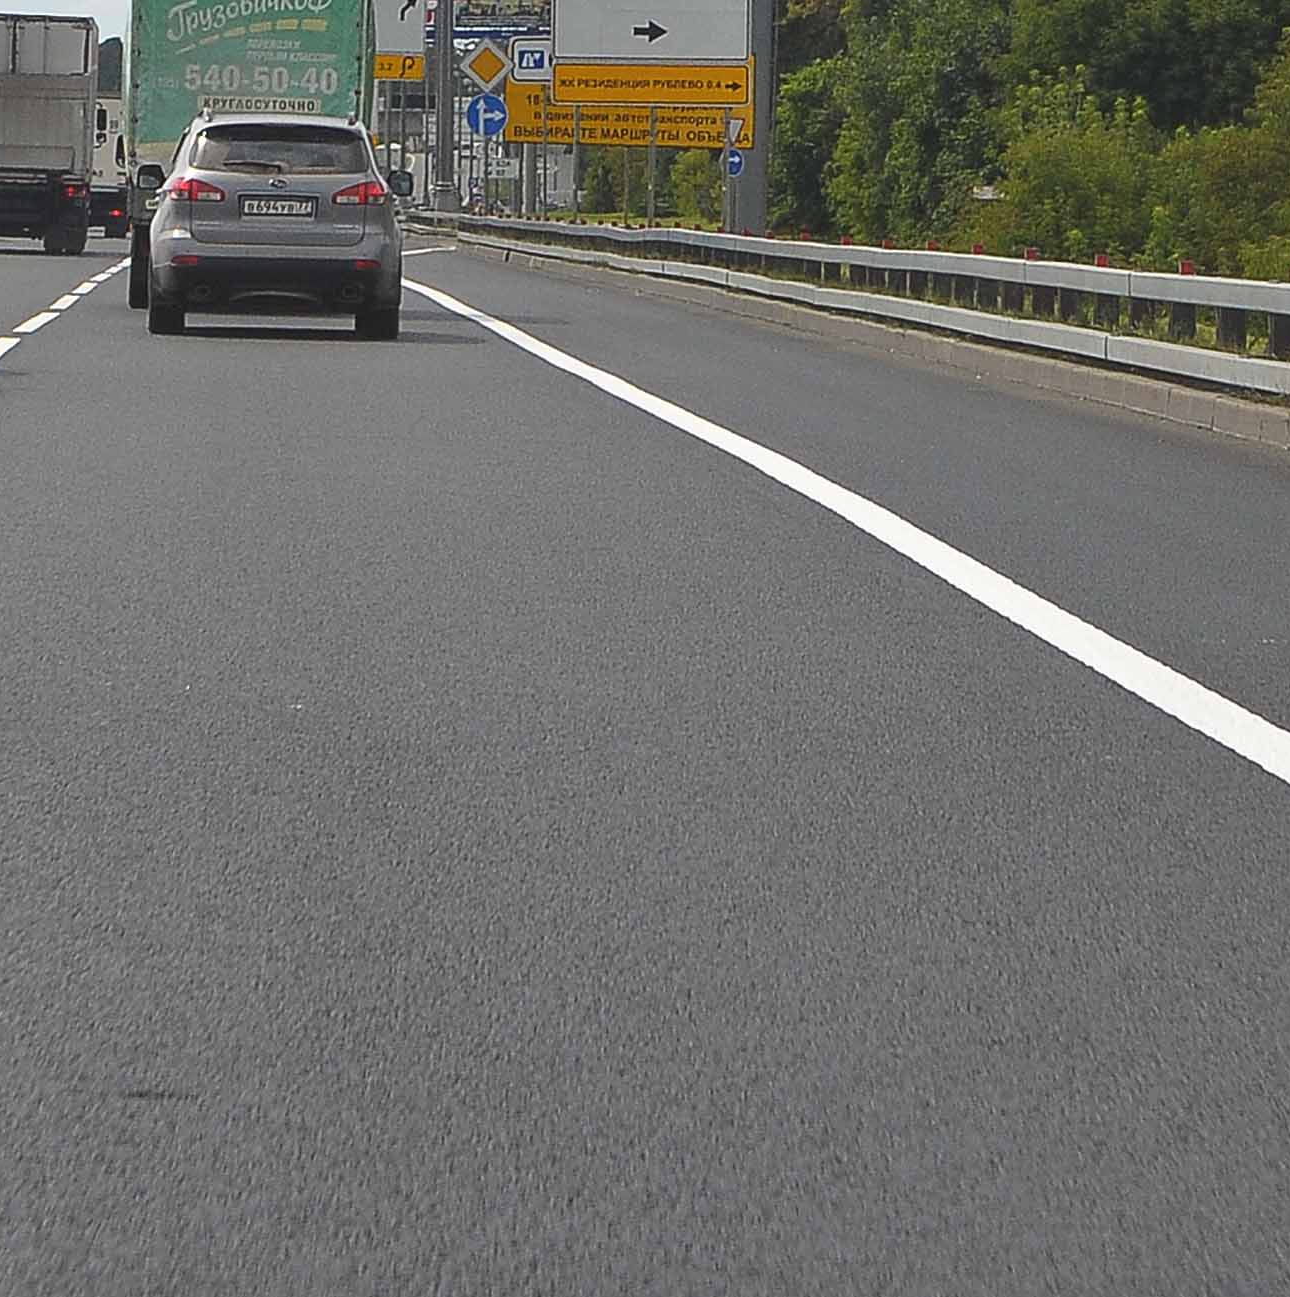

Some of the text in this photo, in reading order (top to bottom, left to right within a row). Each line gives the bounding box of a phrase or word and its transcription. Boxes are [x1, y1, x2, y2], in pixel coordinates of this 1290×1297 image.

[185, 64, 338, 95] 540-50-40
[203, 97, 315, 112] КРУГЛОСУТОЧНО
[614, 113, 717, 126] автотанспорта
[514, 125, 597, 139] ВЫБИРАТЕ
